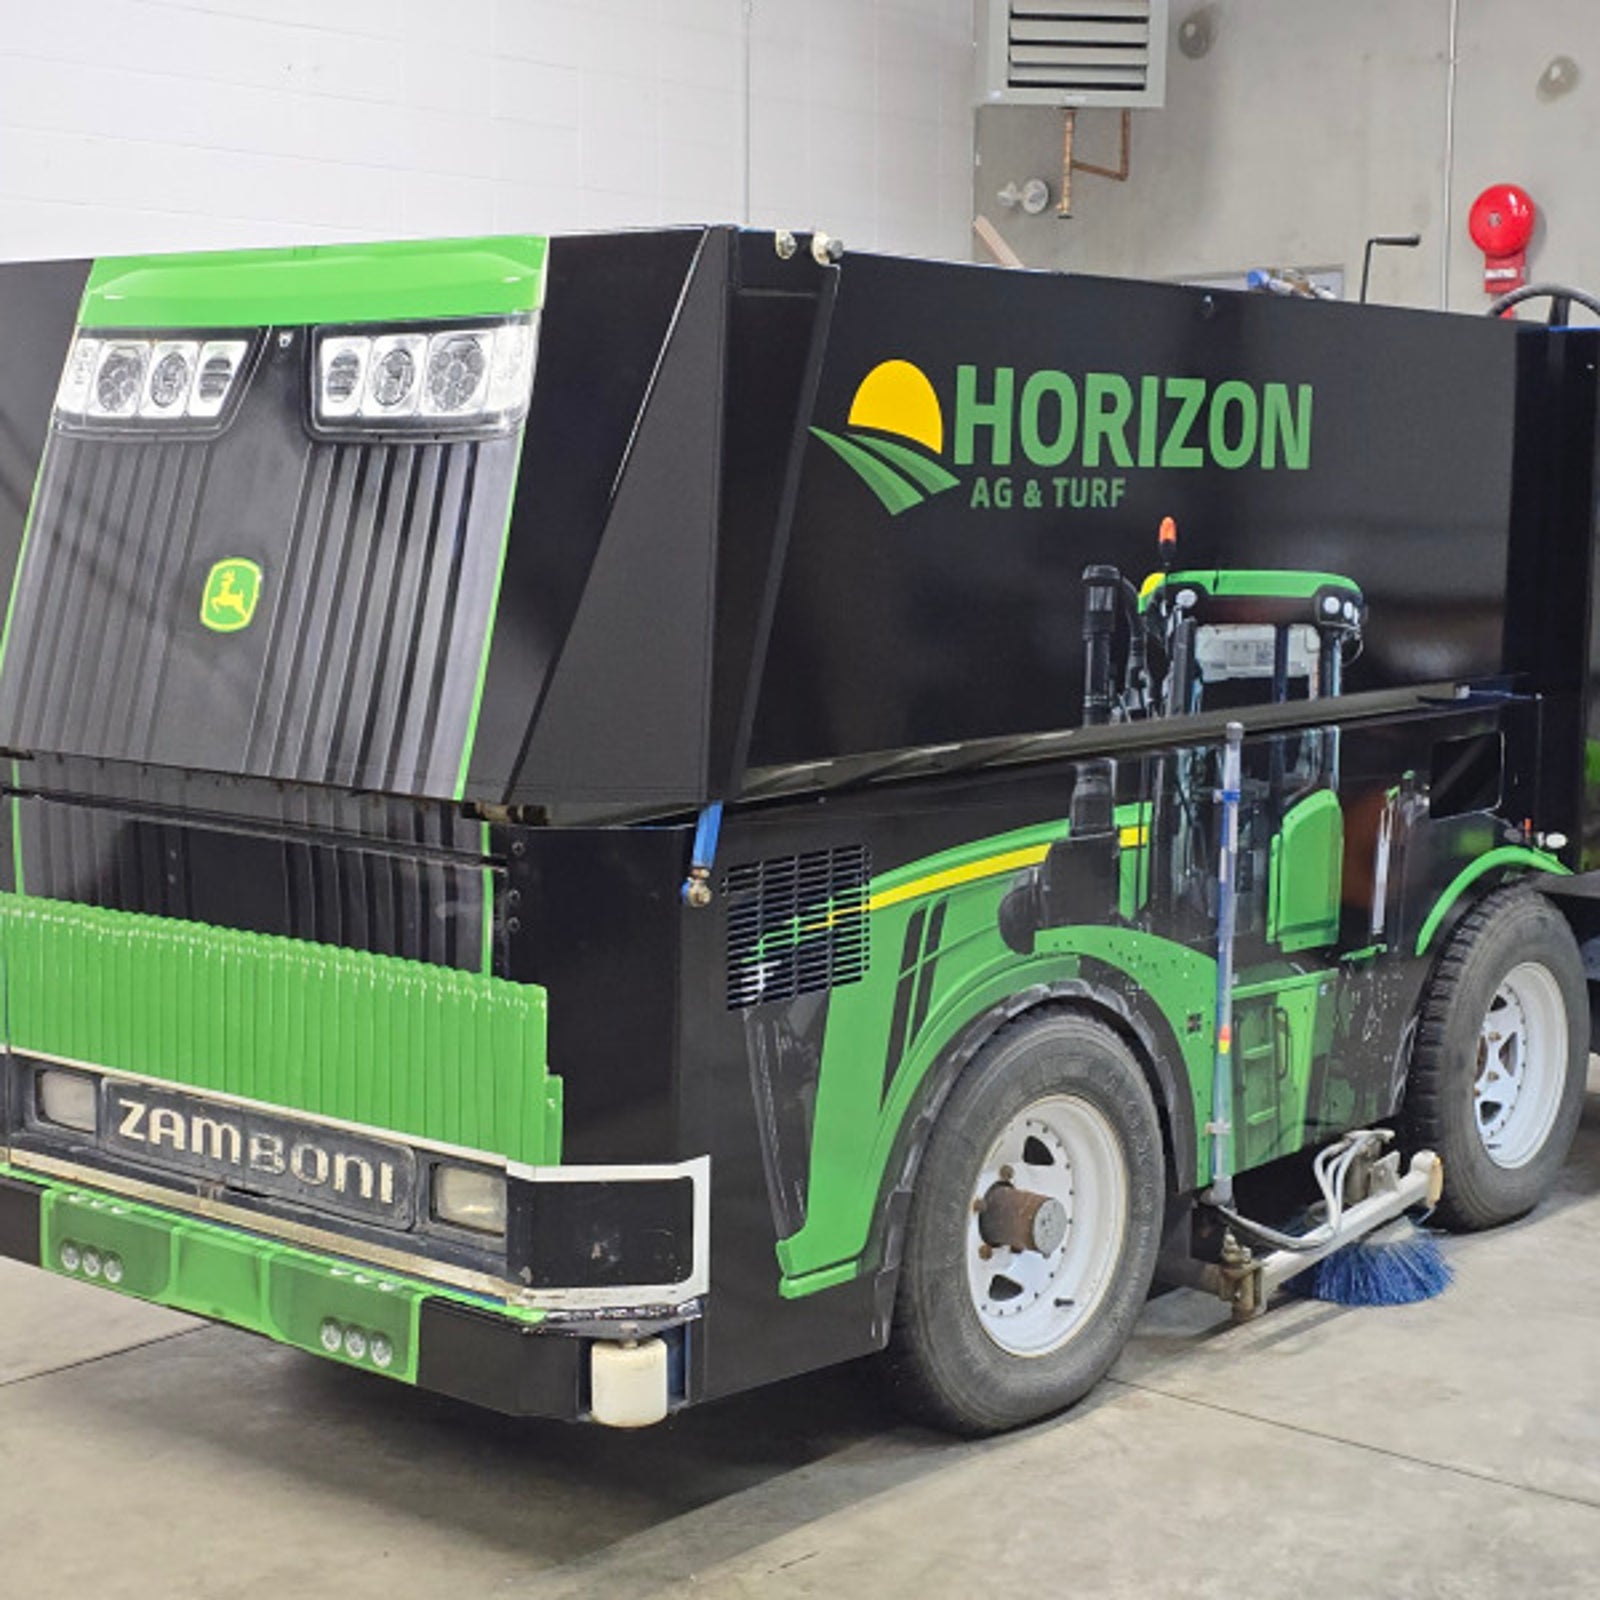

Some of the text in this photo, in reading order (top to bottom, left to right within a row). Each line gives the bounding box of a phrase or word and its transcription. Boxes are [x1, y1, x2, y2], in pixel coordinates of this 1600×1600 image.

[954, 364, 1313, 471] HORIZON
[970, 476, 1126, 509] AG & TURF
[118, 1098, 394, 1205] ZAMBONI
